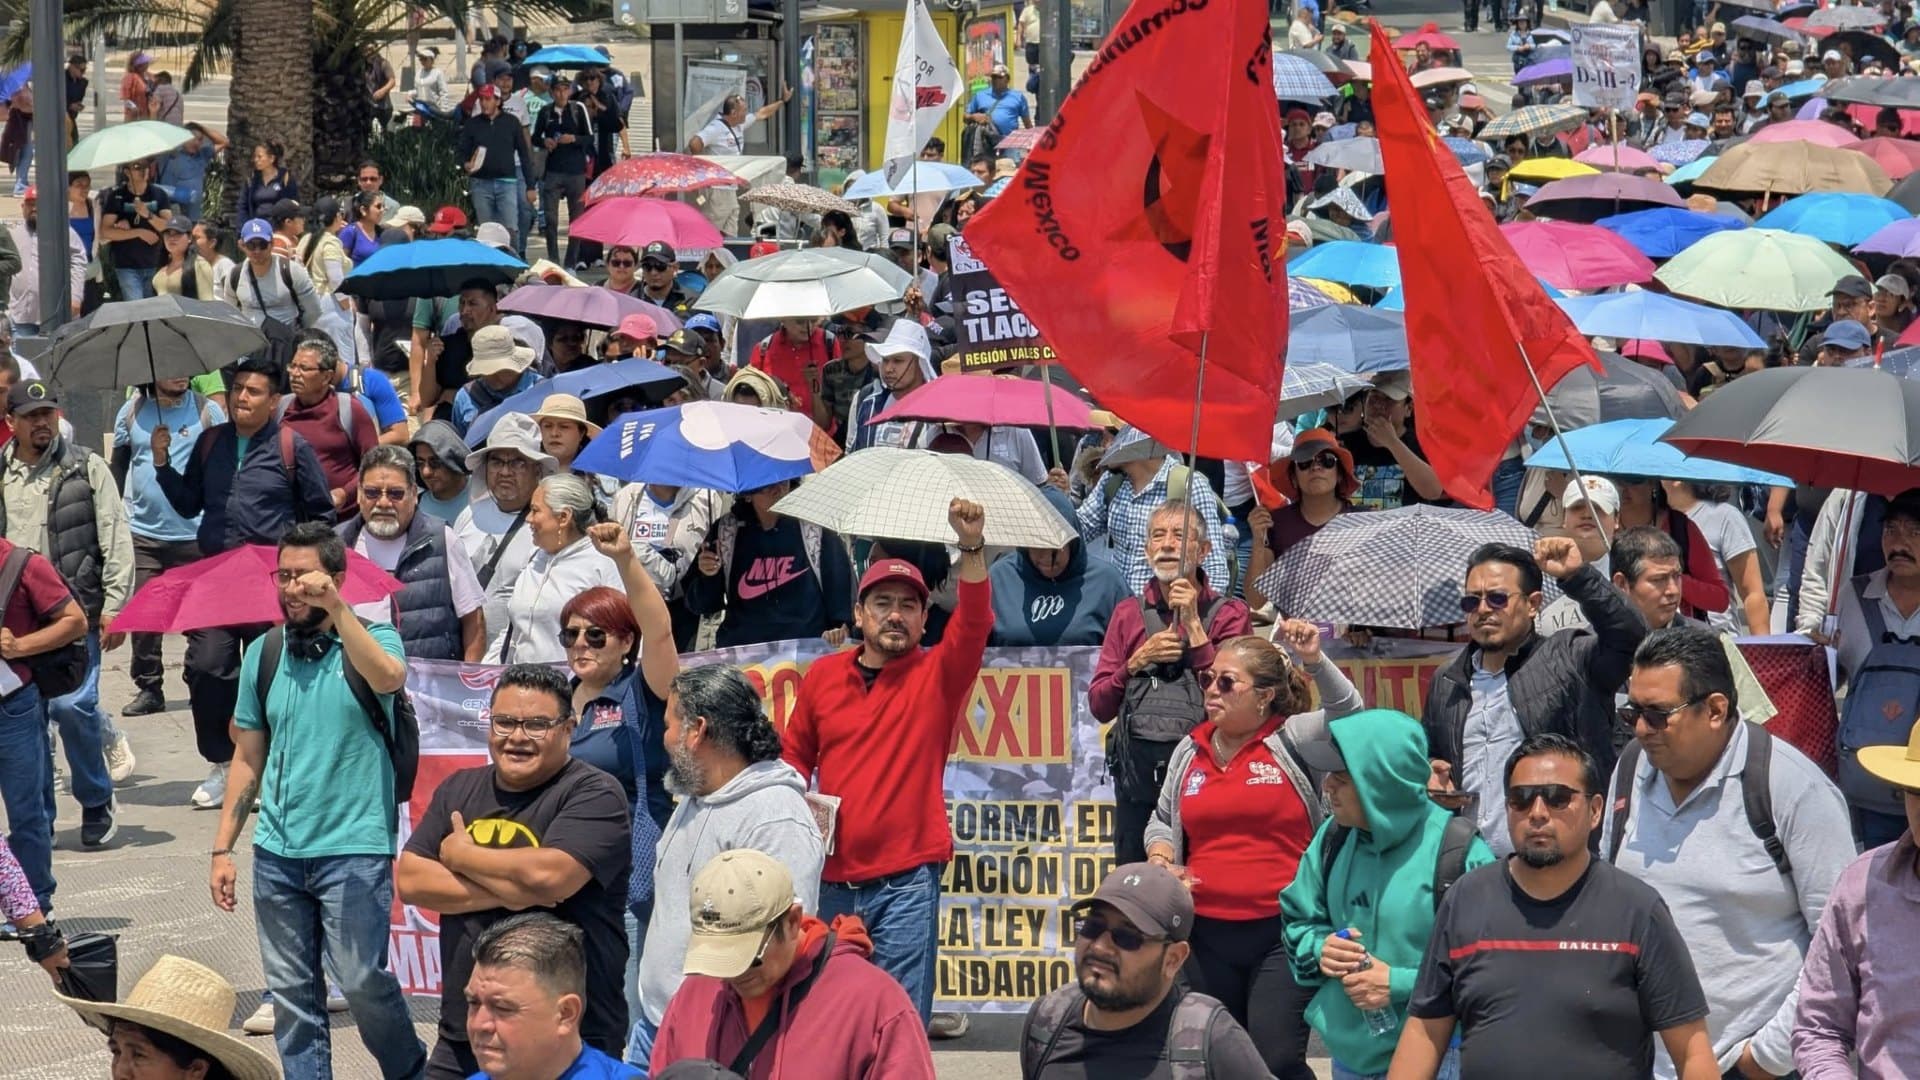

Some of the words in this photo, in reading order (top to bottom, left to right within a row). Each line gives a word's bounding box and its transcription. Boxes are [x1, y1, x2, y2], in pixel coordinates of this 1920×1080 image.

[965, 347, 1008, 366] REGIÓN
[749, 556, 795, 581] NIKE
[985, 908, 1046, 947] LEY
[1559, 940, 1620, 952] OAKLEY
